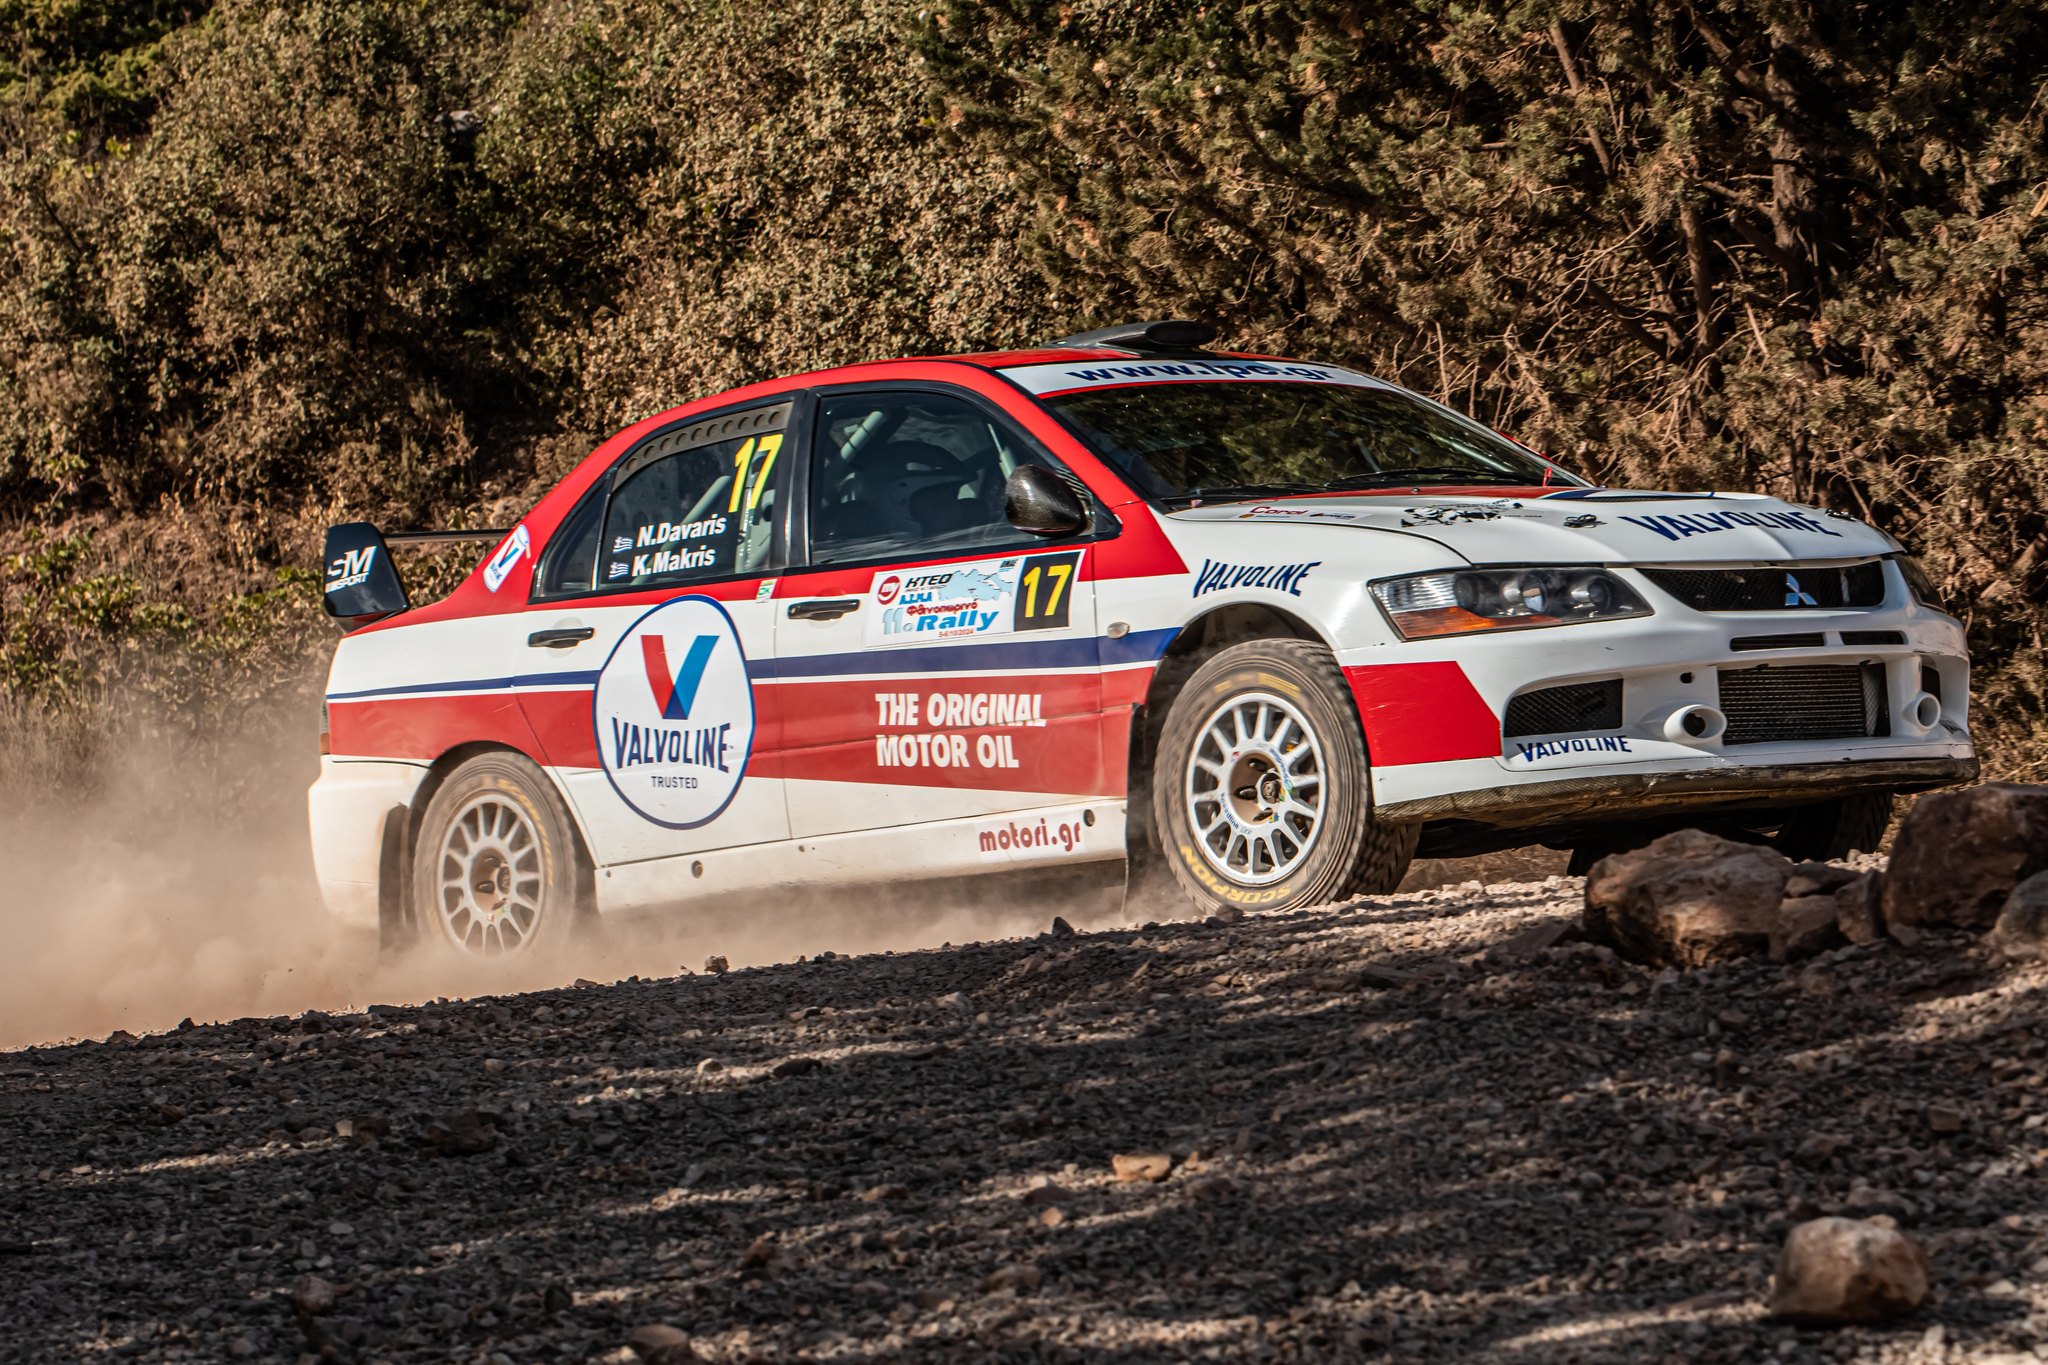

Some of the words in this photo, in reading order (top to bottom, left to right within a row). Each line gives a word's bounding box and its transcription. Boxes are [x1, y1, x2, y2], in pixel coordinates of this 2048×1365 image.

[728, 433, 784, 513] 17
[636, 514, 727, 548] N.Davaris
[1617, 511, 1843, 541] VALVOLINE
[632, 545, 716, 577] K.Makris
[1192, 558, 1322, 598] VALVOLINE
[1023, 564, 1072, 618] 17
[916, 609, 1000, 632] Rally
[875, 693, 918, 726] THE
[927, 693, 1047, 727] ORIGINAL
[611, 716, 731, 774] VALVOLINE
[876, 734, 970, 768] MOTOR
[976, 735, 1019, 768] OIL
[1516, 735, 1632, 762] VALVOLINE
[651, 776, 698, 789] TRUSTED
[979, 817, 1081, 852] motori.gr
[1179, 846, 1291, 904] SCORPION
